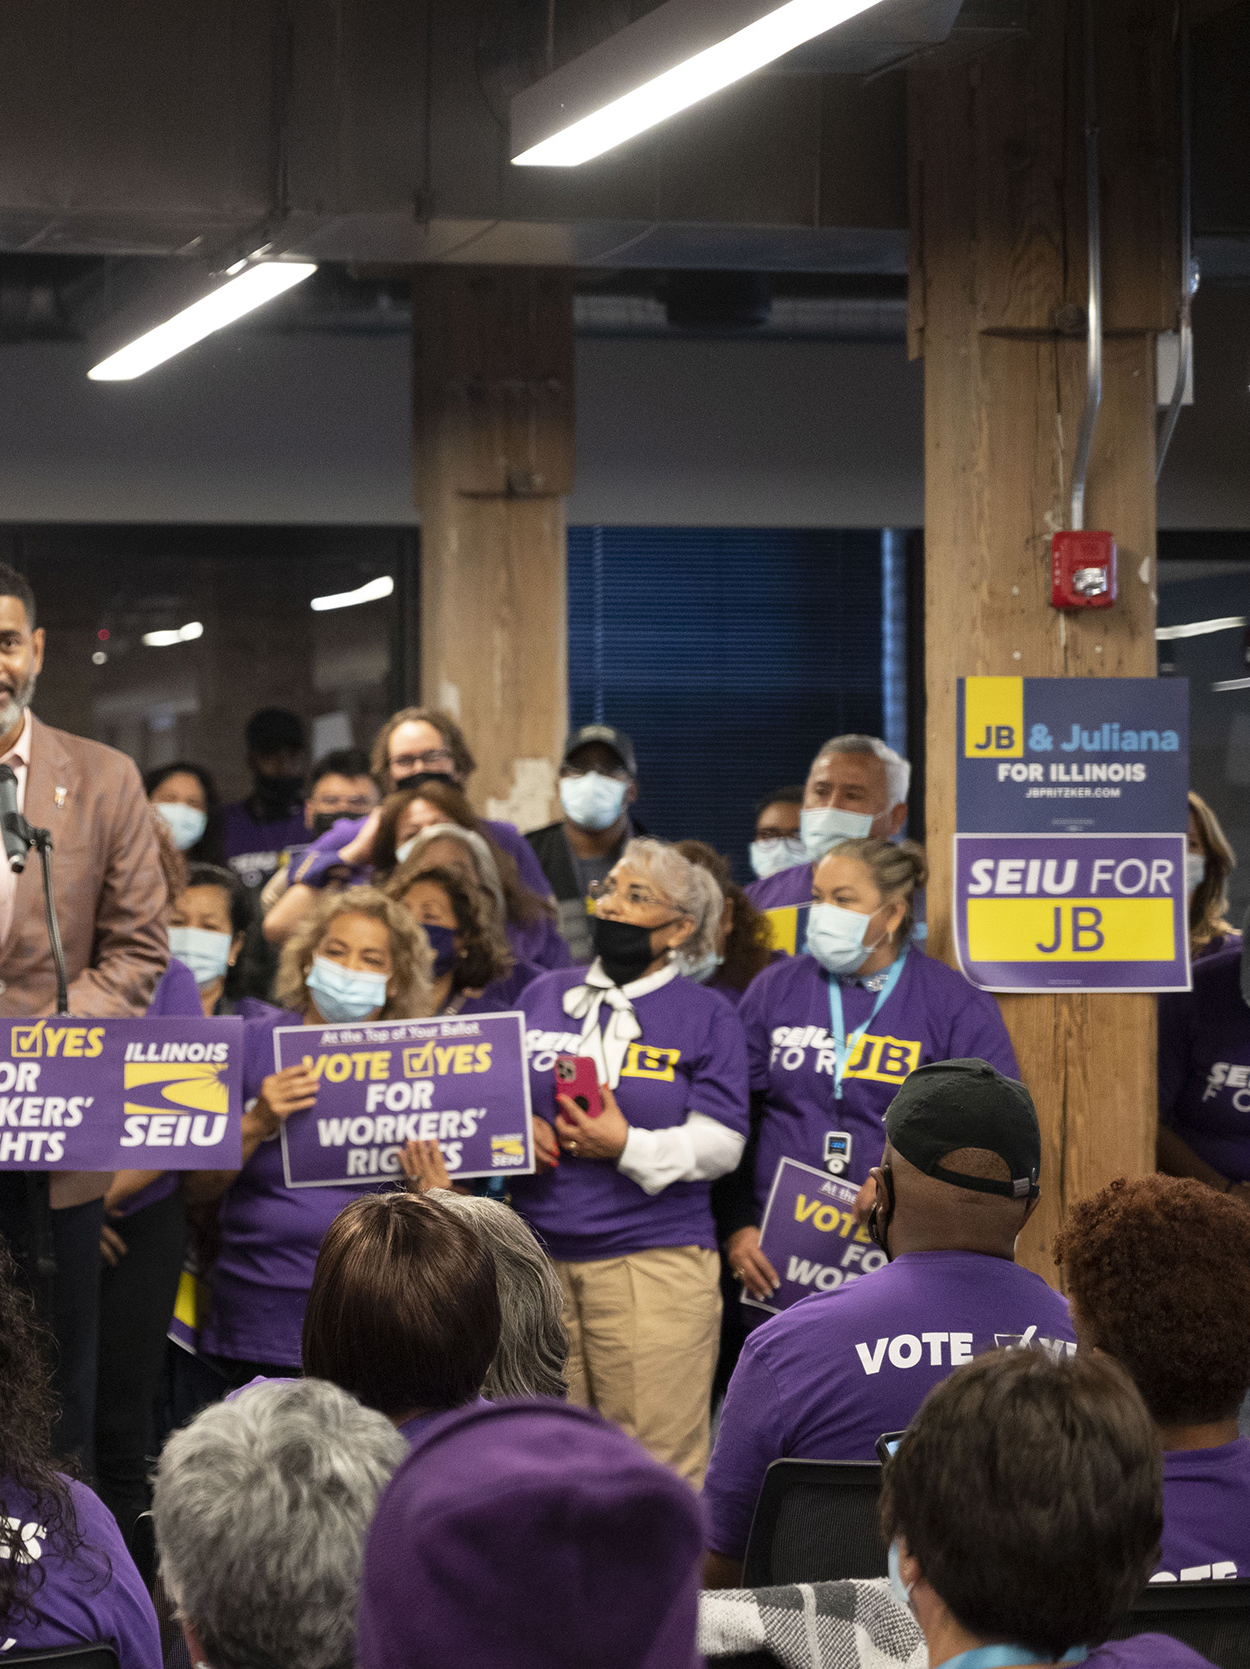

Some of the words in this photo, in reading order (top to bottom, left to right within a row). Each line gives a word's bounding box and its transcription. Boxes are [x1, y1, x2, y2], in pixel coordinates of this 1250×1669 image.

[974, 725, 1016, 750] JB
[1028, 723, 1053, 751] &
[1060, 722, 1180, 751] Juliana
[997, 763, 1044, 782] FOR
[1050, 763, 1146, 782] ILLINOIS
[1024, 787, 1121, 799] JBPRITZKER.COM
[968, 858, 1079, 895] SEIU
[1090, 857, 1174, 895] FOR
[1035, 906, 1105, 954] JB
[43, 1027, 106, 1058] YES
[364, 1026, 390, 1044] Top
[408, 1023, 439, 1039] Your
[440, 1020, 481, 1036] Ballot
[124, 1042, 229, 1063] ILLINOIS
[433, 1042, 493, 1076] YES
[848, 1040, 911, 1077] JB
[366, 1080, 435, 1113] FOR
[119, 1115, 229, 1148] SEIU
[317, 1107, 488, 1147] WORKERS'
[346, 1140, 464, 1176] RIGS
[821, 1180, 839, 1197] At
[840, 1243, 888, 1274] FO
[854, 1332, 975, 1376] VOTE
